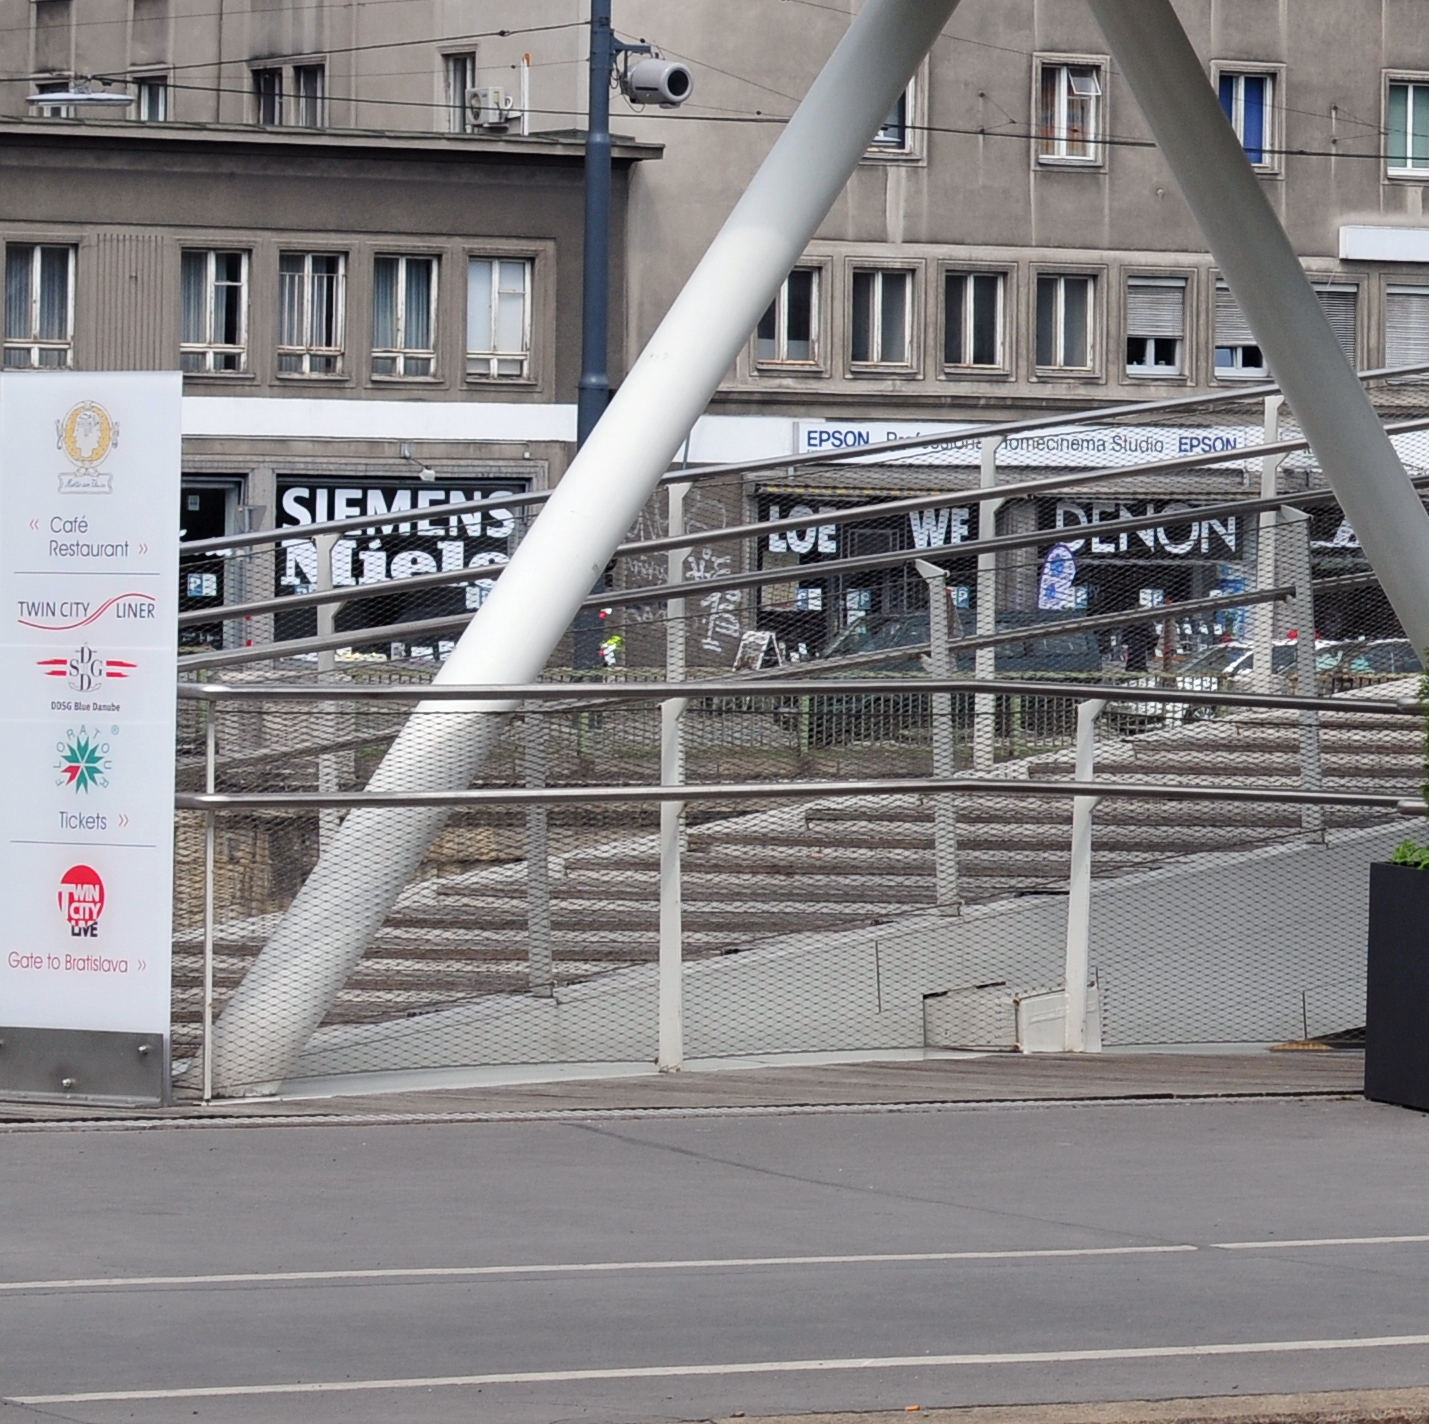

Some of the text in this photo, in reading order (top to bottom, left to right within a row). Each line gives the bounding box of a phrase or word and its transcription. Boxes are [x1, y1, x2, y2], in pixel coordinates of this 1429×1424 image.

[807, 430, 871, 448] EPSON
[1112, 435, 1164, 454] Studio
[1178, 436, 1237, 454] EPSON
[281, 487, 516, 538] SIEMENS
[50, 515, 89, 534] Café
[1055, 501, 1237, 554] DENON
[49, 539, 130, 558] Restaurant
[17, 601, 156, 619] TWIN CITY LINER
[51, 701, 121, 712] DDSG Blue Danube
[59, 811, 108, 830] Tickets
[70, 902, 101, 919] CITY
[71, 919, 98, 937] LIVE
[8, 951, 128, 973] Gate to Bratislava
